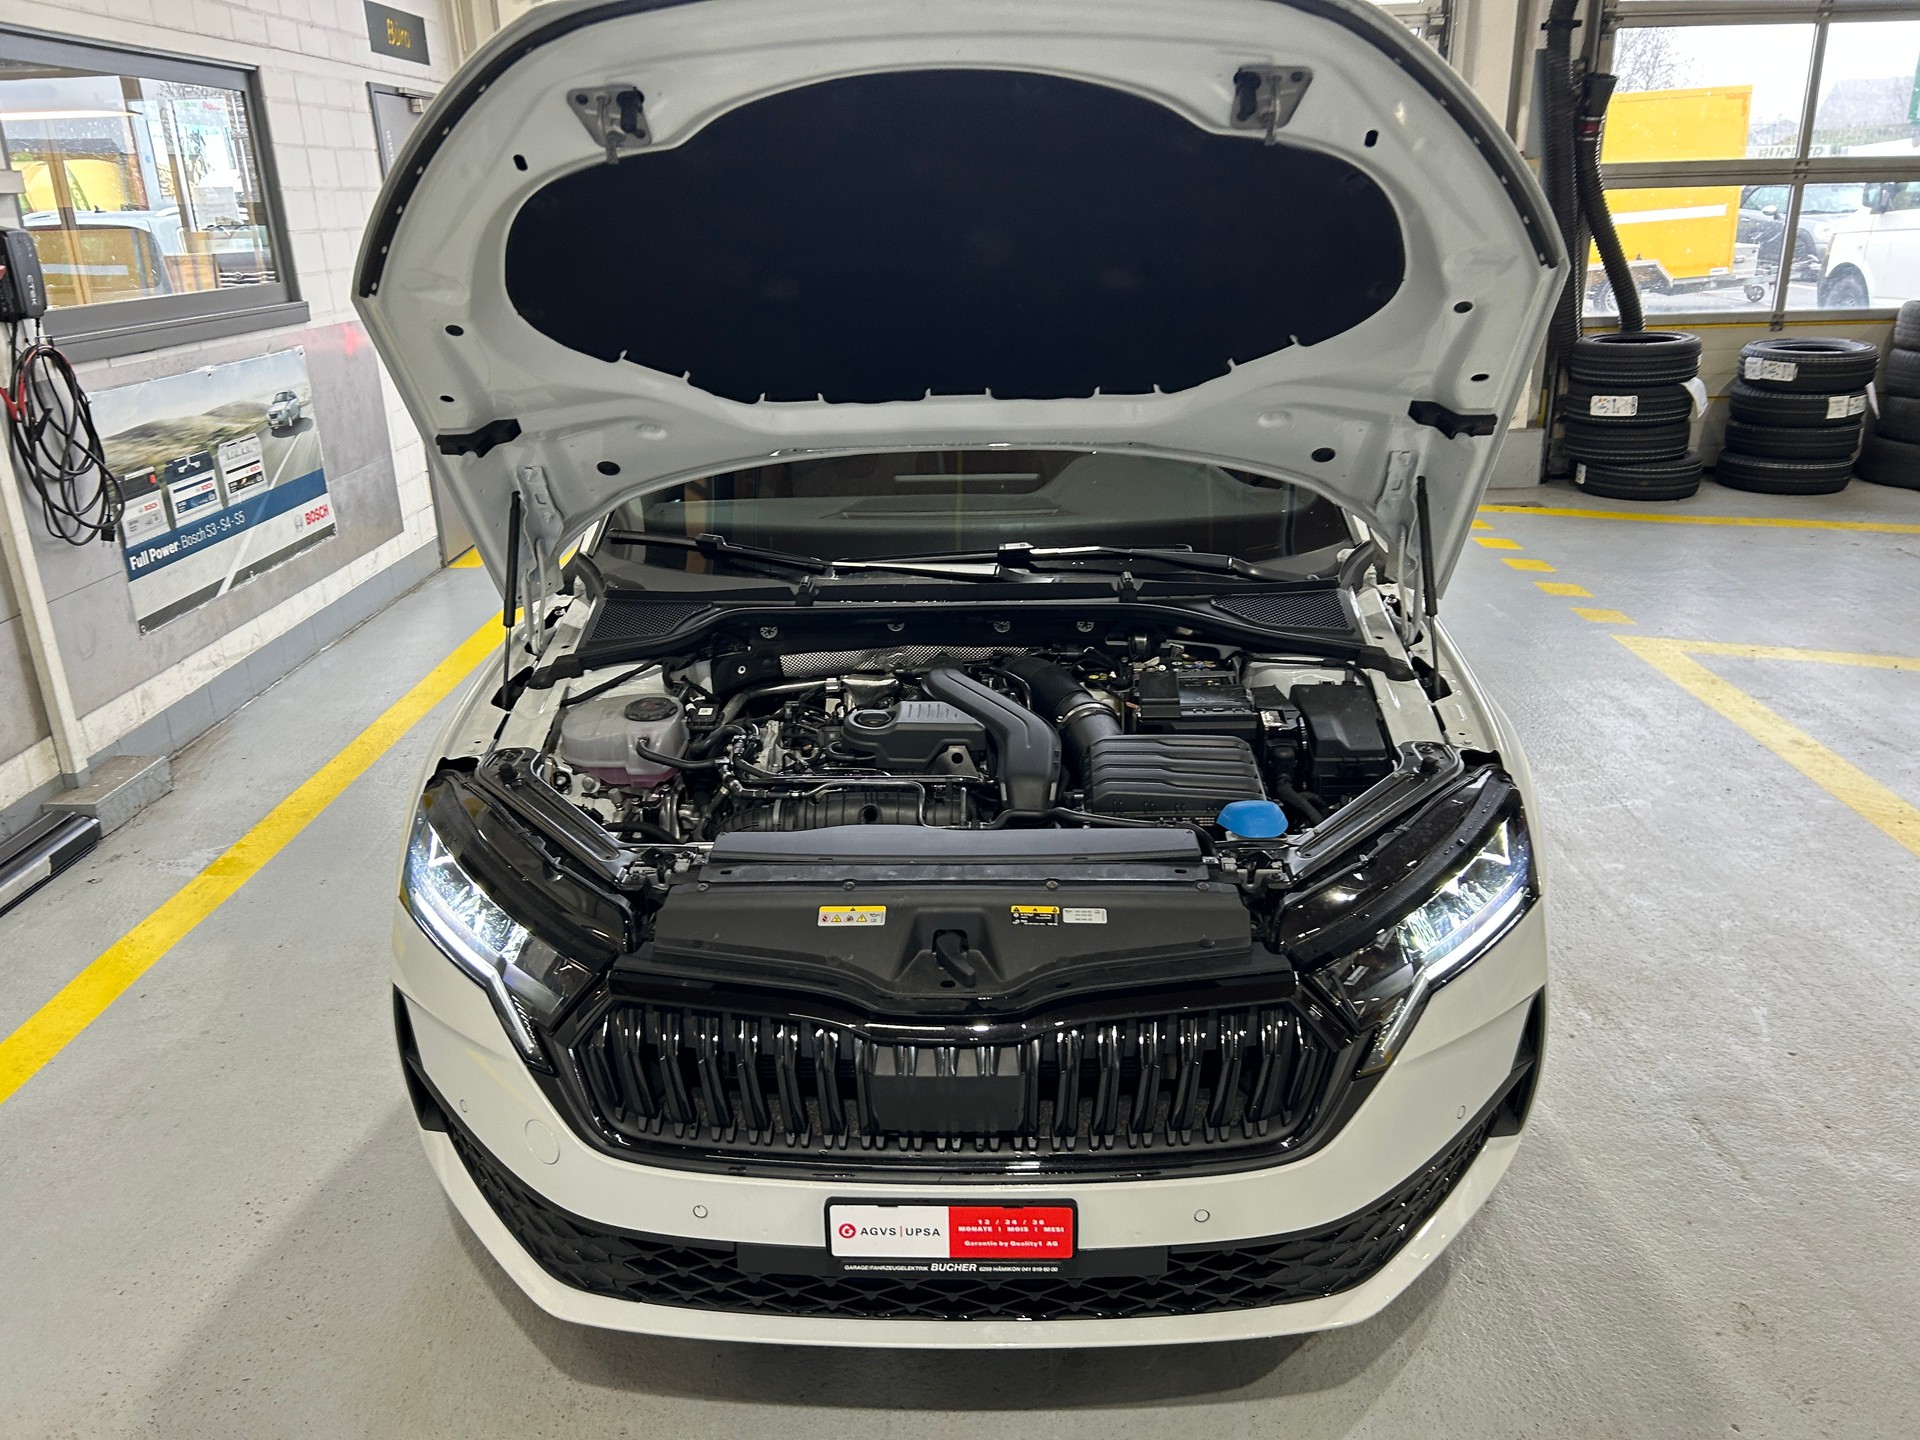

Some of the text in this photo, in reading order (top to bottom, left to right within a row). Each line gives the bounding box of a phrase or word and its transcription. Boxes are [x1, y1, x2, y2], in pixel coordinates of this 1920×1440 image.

[304, 503, 330, 526] BOSCH
[129, 550, 149, 571] Full
[149, 541, 182, 561] Power:
[181, 527, 206, 549] Bosch
[930, 1263, 978, 1272] BUCHER
